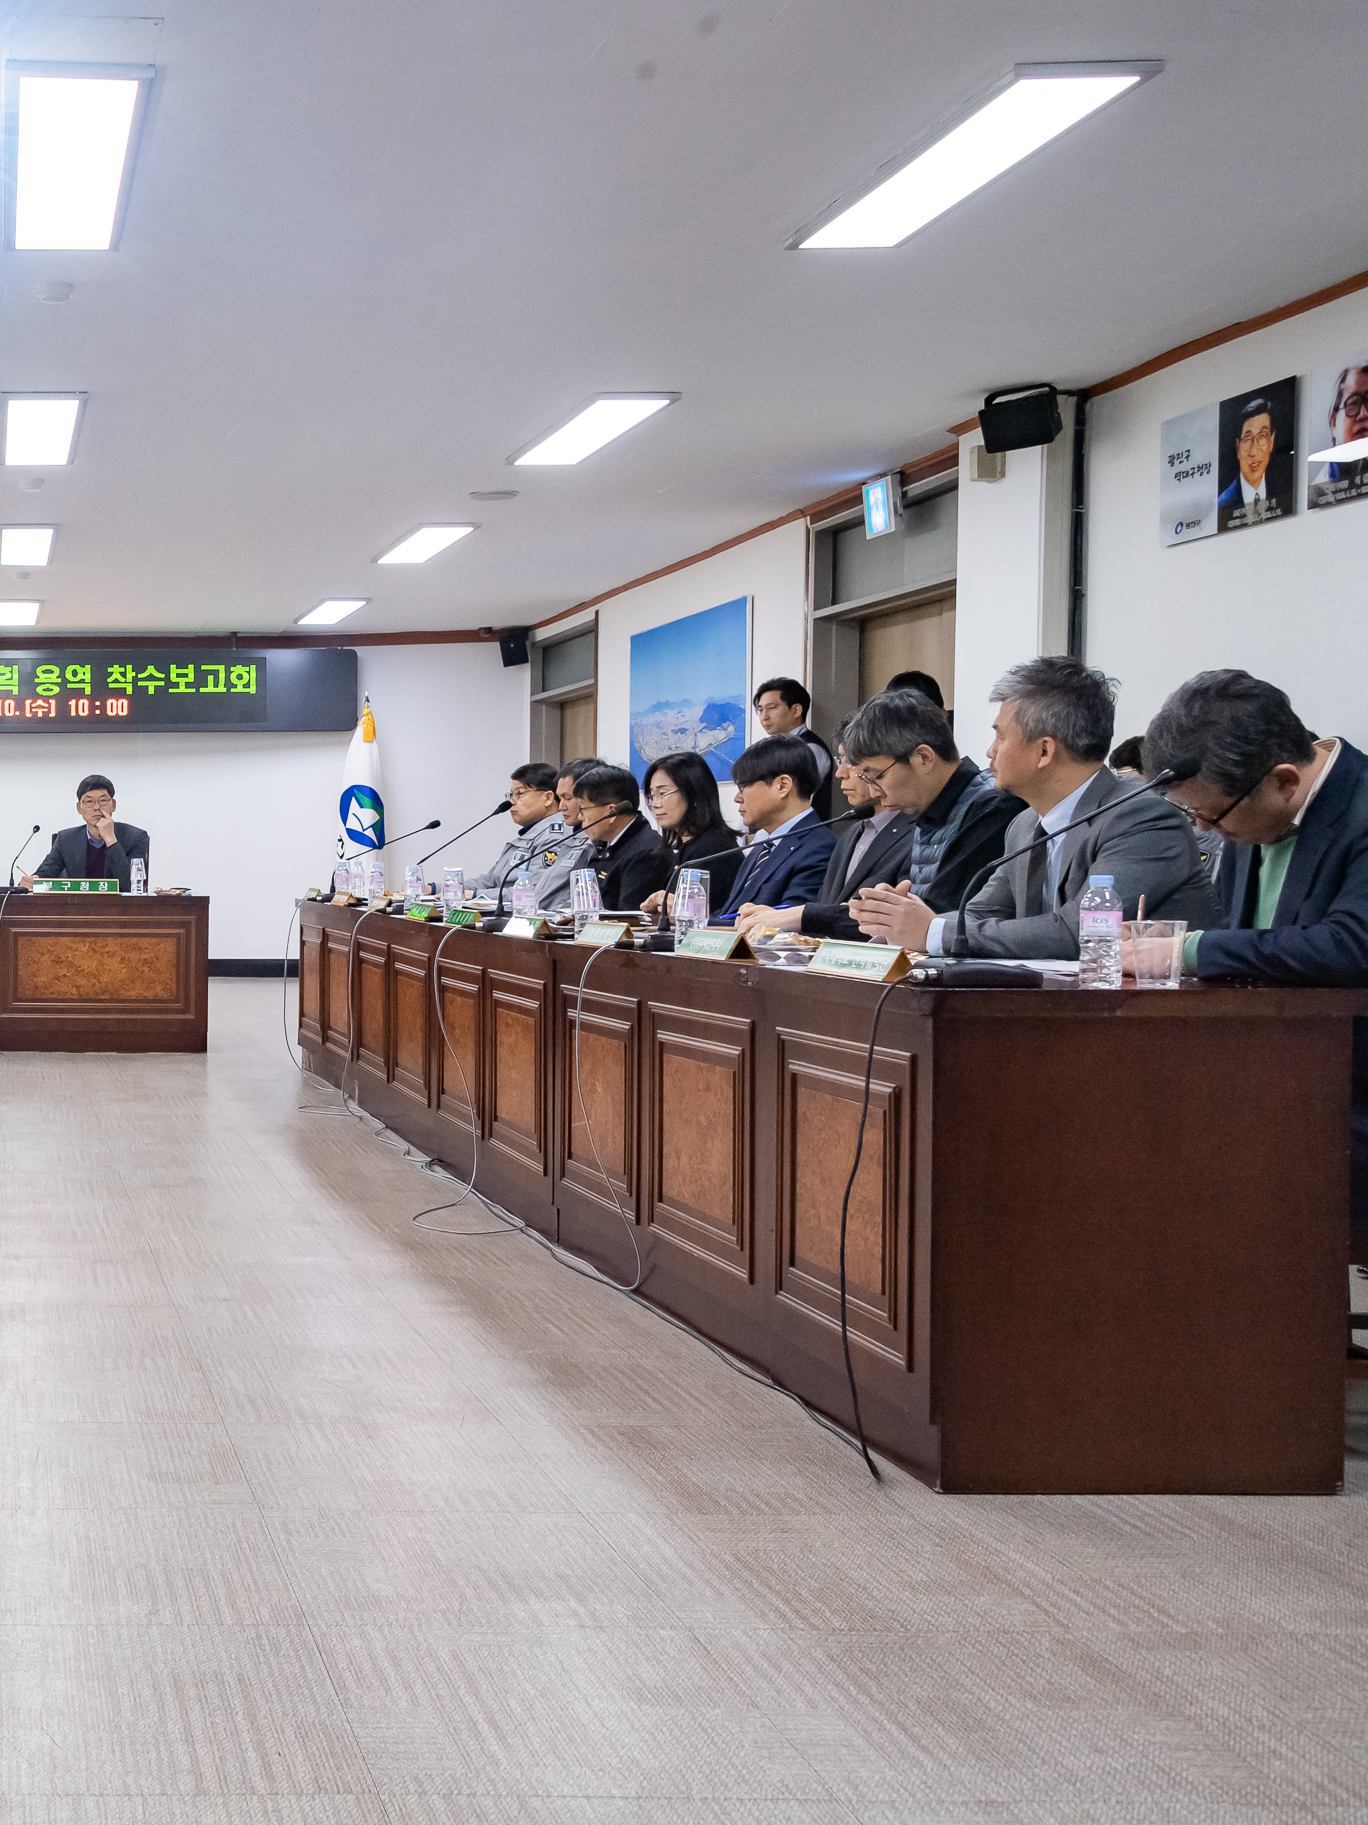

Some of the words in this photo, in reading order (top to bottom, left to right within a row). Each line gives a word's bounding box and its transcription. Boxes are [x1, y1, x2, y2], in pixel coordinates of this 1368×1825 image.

[1167, 449, 1191, 467] 광진구
[1174, 462, 1212, 483] 역대구청장
[34, 664, 92, 696] 용역
[106, 664, 257, 695] 착수보고회
